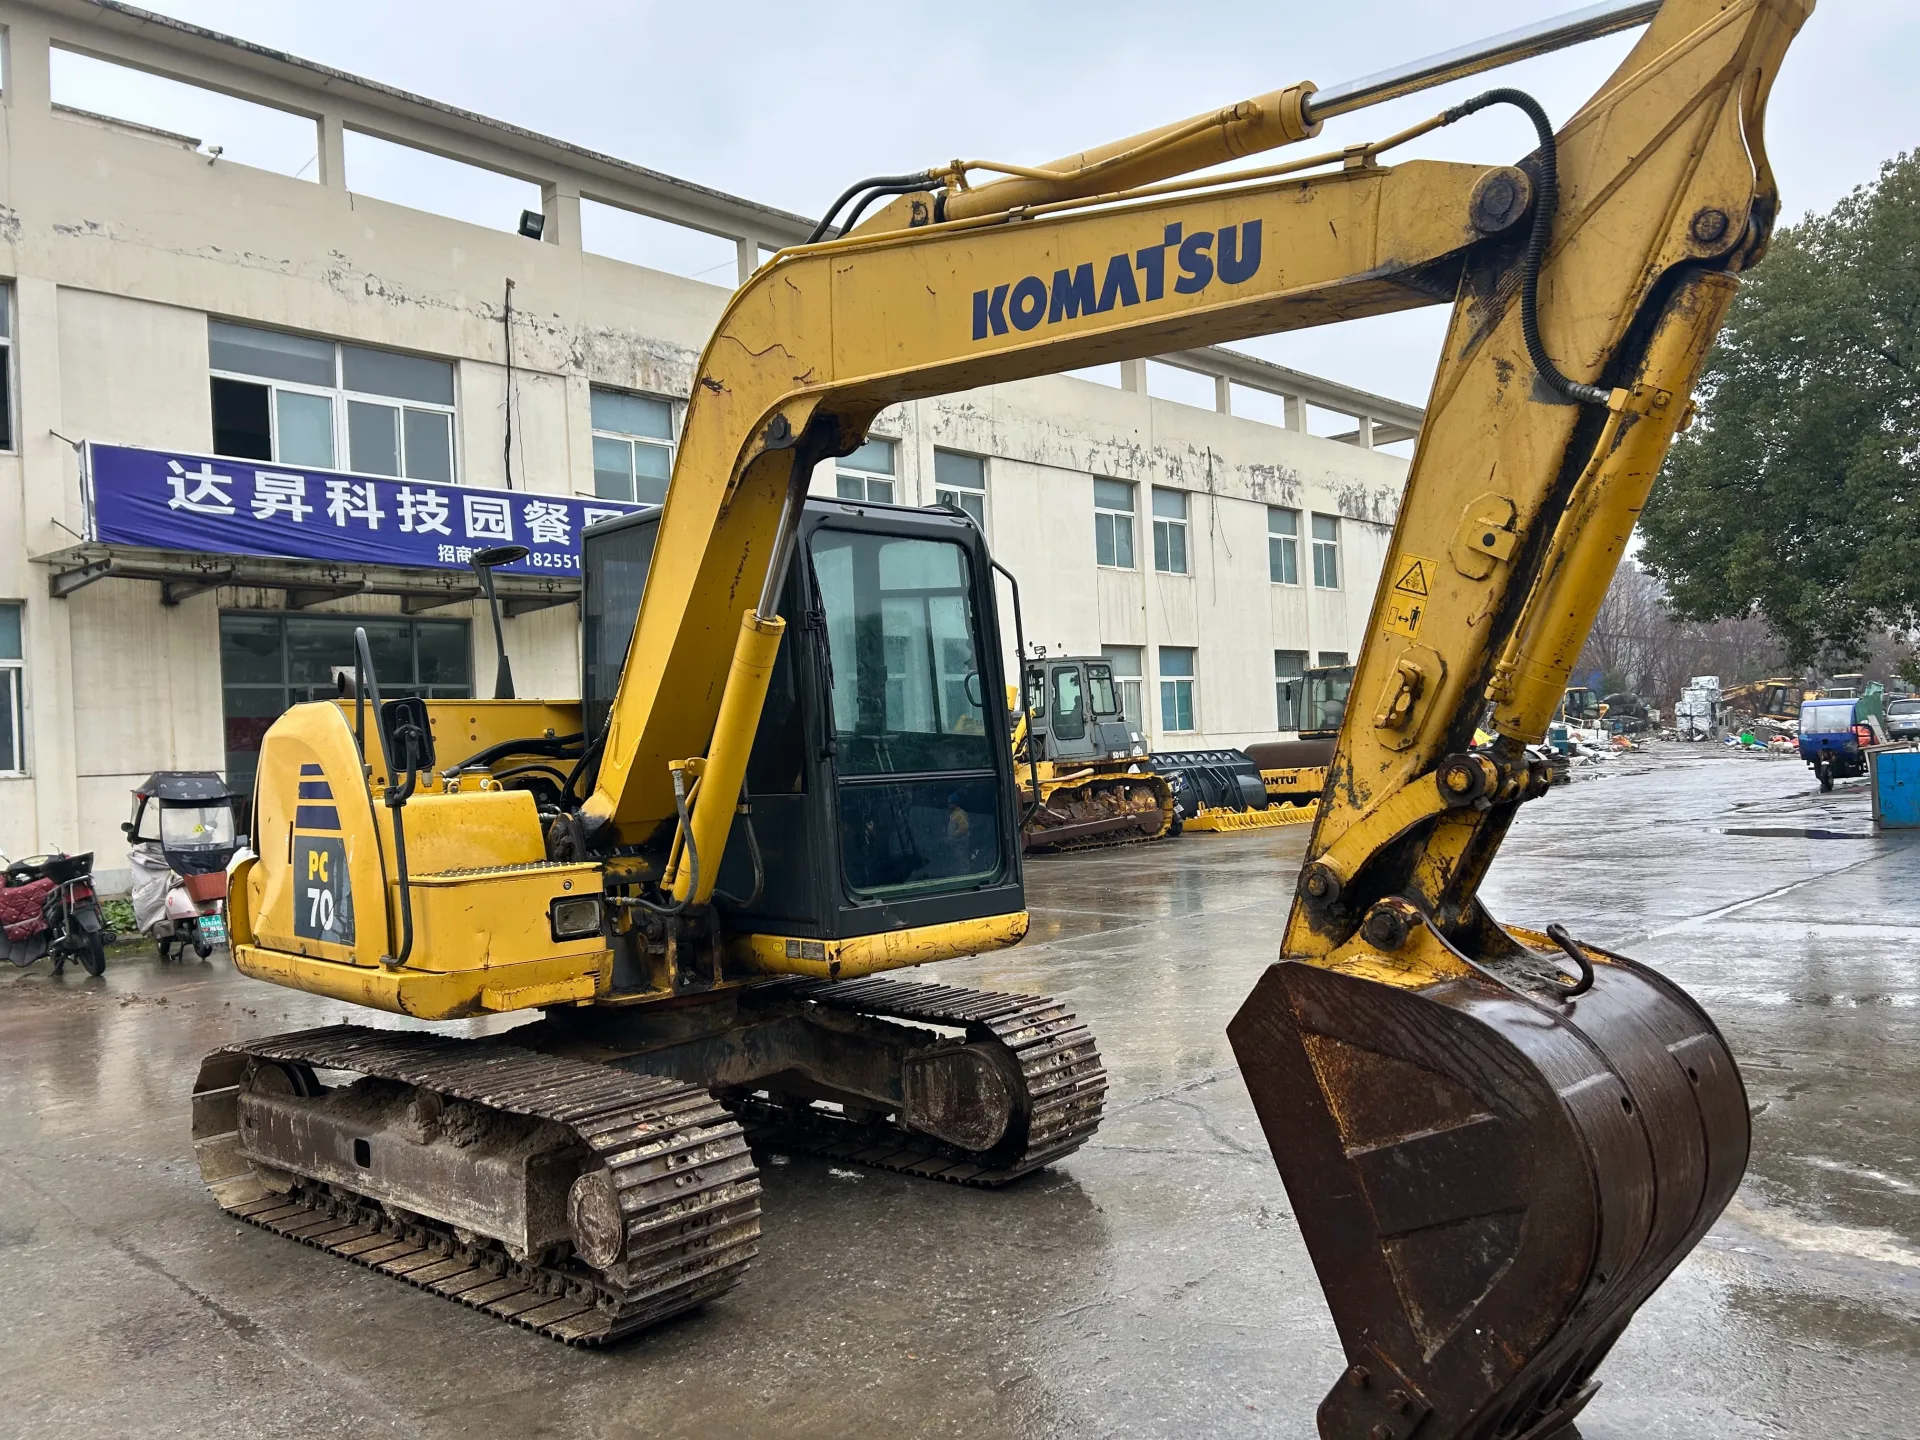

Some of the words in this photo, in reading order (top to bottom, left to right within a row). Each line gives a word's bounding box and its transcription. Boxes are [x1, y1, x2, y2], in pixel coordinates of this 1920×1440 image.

[972, 218, 1263, 341] KOMATSU
[308, 850, 329, 882] PC
[307, 887, 334, 931] 70
